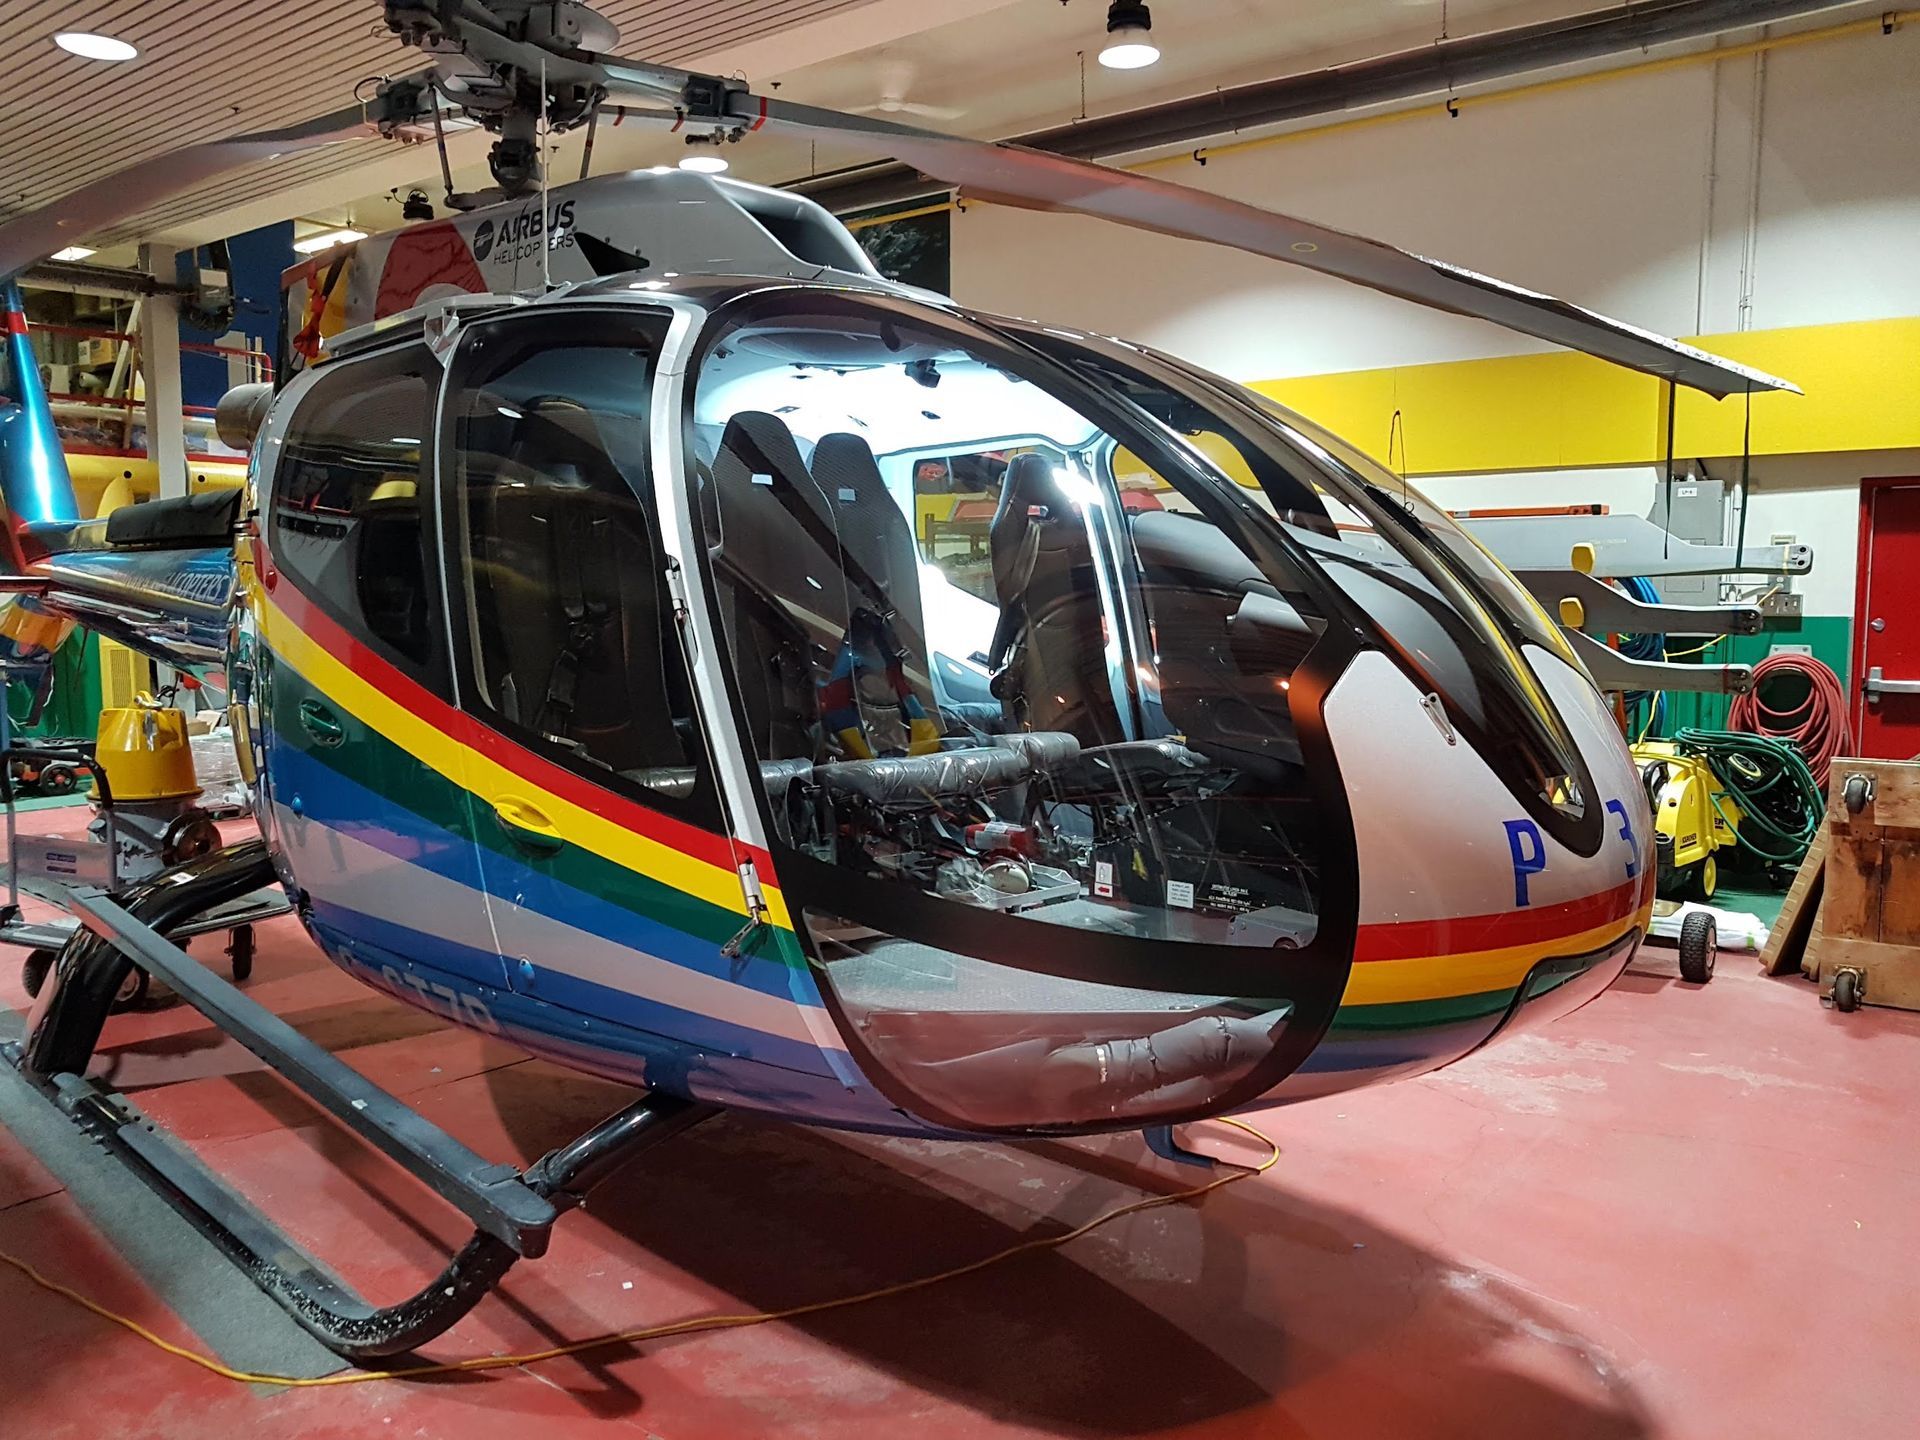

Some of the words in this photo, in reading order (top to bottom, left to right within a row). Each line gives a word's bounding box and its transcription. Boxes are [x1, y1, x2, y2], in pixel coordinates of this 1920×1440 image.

[496, 200, 576, 248] AIRBUS
[494, 233, 575, 265] HELICOPERS
[1502, 819, 1546, 907] P
[1605, 799, 1641, 879] 3
